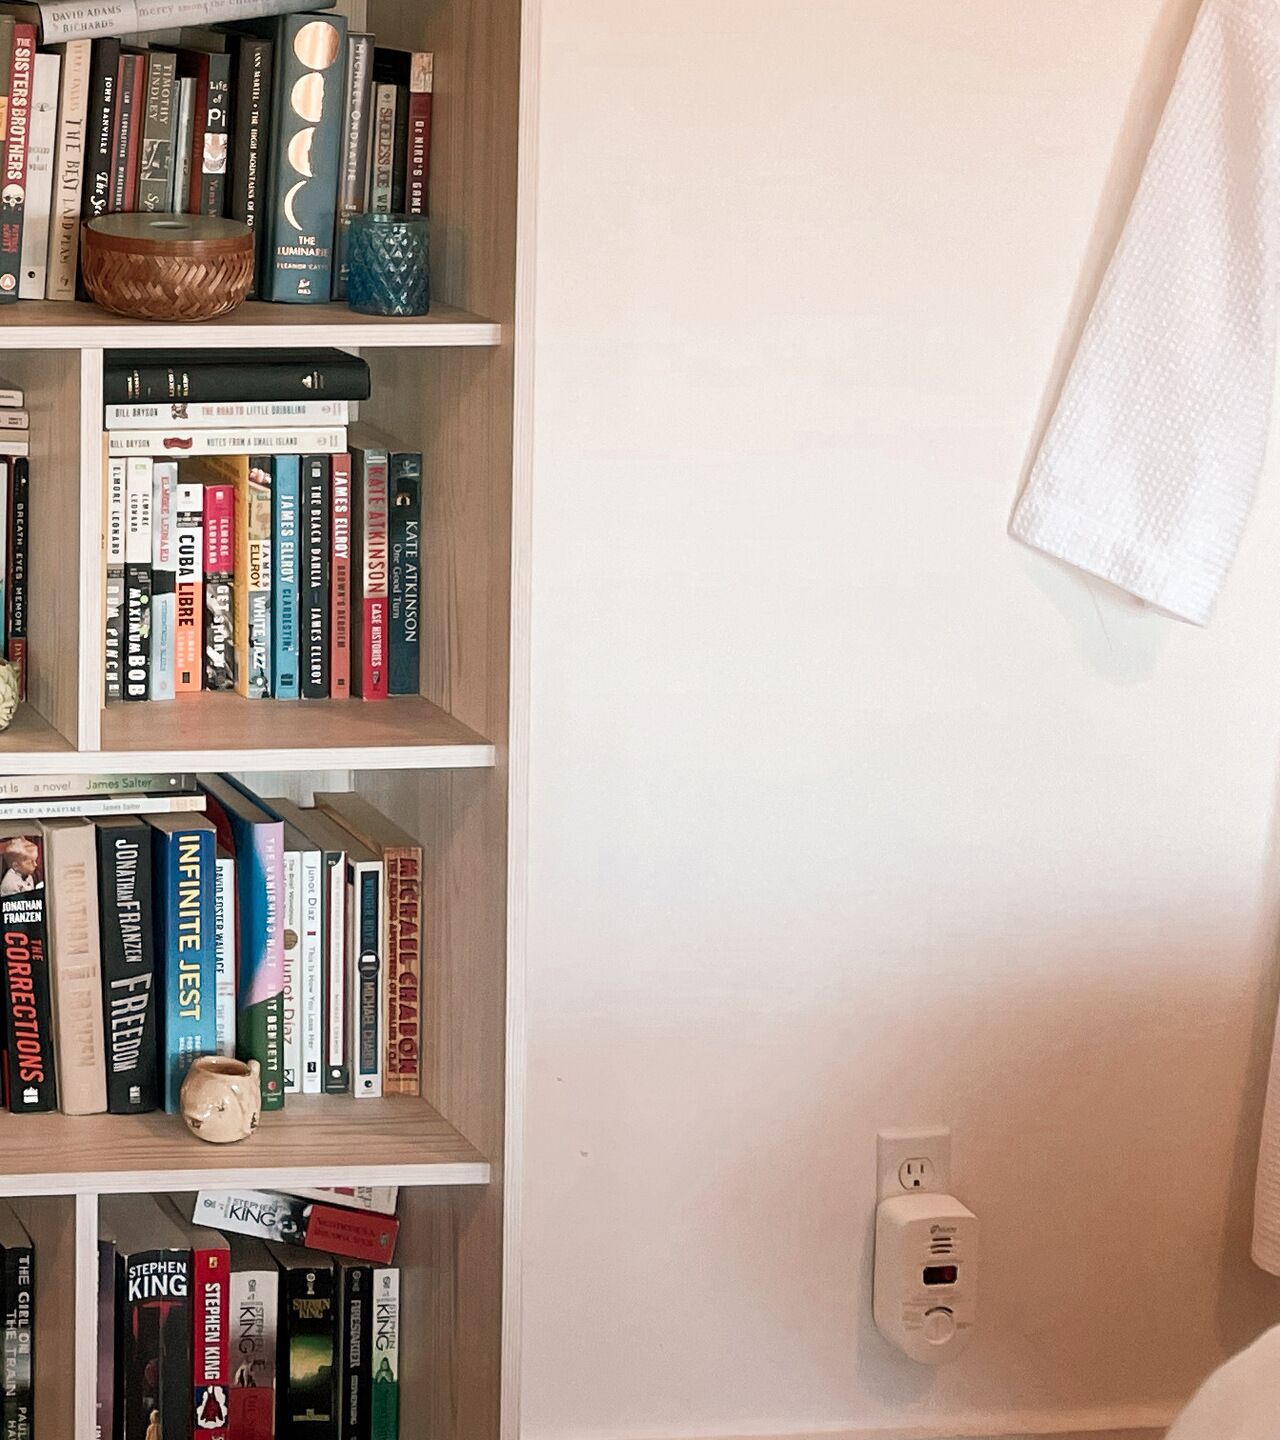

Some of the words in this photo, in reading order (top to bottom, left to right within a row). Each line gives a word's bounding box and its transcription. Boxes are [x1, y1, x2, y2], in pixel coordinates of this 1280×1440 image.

[52, 11, 84, 22] DAVID
[87, 5, 122, 18] ADAMS
[63, 20, 115, 33] RICHARDS
[13, 48, 31, 108] SISTERS
[149, 63, 162, 123] FINDLEY
[161, 63, 173, 125] TIMOTHY
[210, 81, 228, 91] Life
[352, 43, 364, 106] MICHAEL
[208, 108, 227, 127] Pi
[213, 94, 222, 104] of
[7, 109, 27, 180] BROTHERS
[347, 110, 361, 182] ONDAATJE
[311, 485, 322, 506] THE
[334, 471, 348, 509] JAMES
[368, 465, 385, 506] KATE
[280, 495, 294, 537] JAMES
[311, 508, 322, 538] BLACK
[334, 512, 348, 560] ELLROY
[405, 520, 419, 556] KATE
[178, 534, 195, 577] CUBA
[249, 544, 261, 589] ELLROY
[280, 540, 294, 584] ELLROY
[310, 547, 321, 588] DAHLIA
[367, 511, 386, 594] ATKINSON
[177, 582, 195, 627] LIBRE
[310, 607, 321, 638] JAMES
[403, 562, 418, 643] ATKINSON
[310, 640, 321, 686] ELLROY
[115, 839, 139, 901] JONATHAN
[2, 899, 43, 913] JONATHAN
[178, 834, 201, 953] INFINITE
[399, 857, 418, 964] MICHAEL
[4, 912, 42, 924] FRANZEN
[118, 900, 143, 963] FRANZEN
[3, 931, 45, 1083] CORRECTIONS
[178, 959, 201, 1022] JEST
[110, 971, 153, 1074] FREEDOM
[398, 971, 418, 1074] CHABON
[229, 1205, 276, 1227] KING
[17, 1255, 30, 1285] THE
[128, 1275, 188, 1302] KING
[129, 1262, 187, 1277] STEPHEN
[5, 1310, 17, 1341] THE
[17, 1292, 30, 1328] GIRL
[204, 1282, 221, 1344] STEPHEN
[239, 1307, 255, 1354] KING
[376, 1304, 390, 1351] KING
[18, 1334, 30, 1354] ON
[204, 1347, 220, 1380] KING
[5, 1346, 17, 1397] TRAIN
